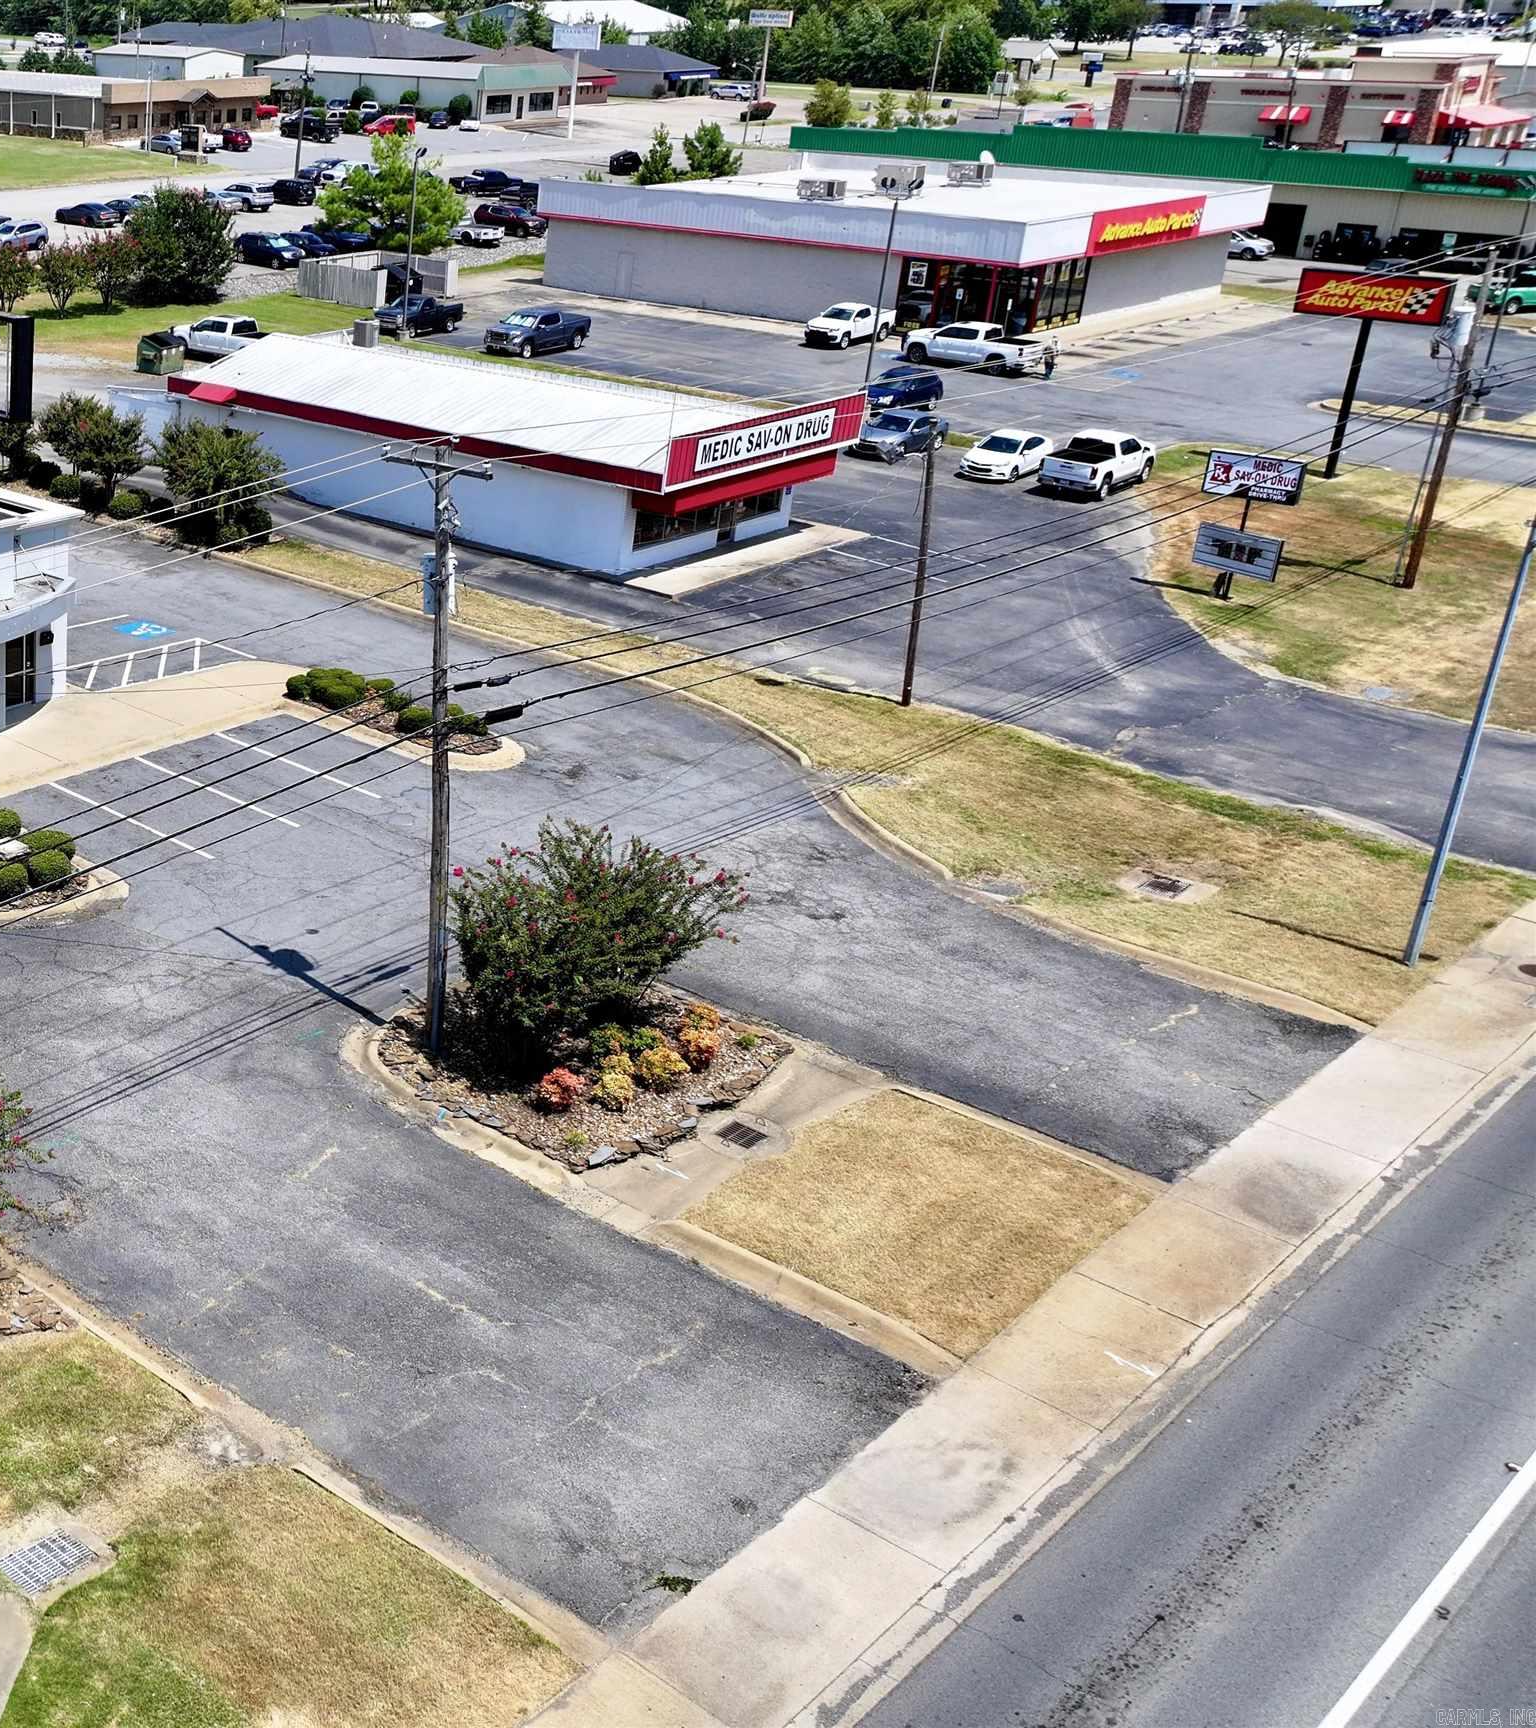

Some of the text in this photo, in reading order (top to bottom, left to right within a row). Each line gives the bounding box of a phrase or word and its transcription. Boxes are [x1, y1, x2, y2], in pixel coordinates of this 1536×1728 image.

[1099, 211, 1194, 243] Advance Auto Parts
[1317, 279, 1404, 300] Advance
[1306, 293, 1396, 312] Auto Parts
[700, 415, 830, 465] MEDIC SAV-ON DRUG
[1253, 460, 1284, 473] MEDIC
[1234, 469, 1298, 489] SAV-ON DRUG
[1250, 486, 1287, 496] PHARMACY
